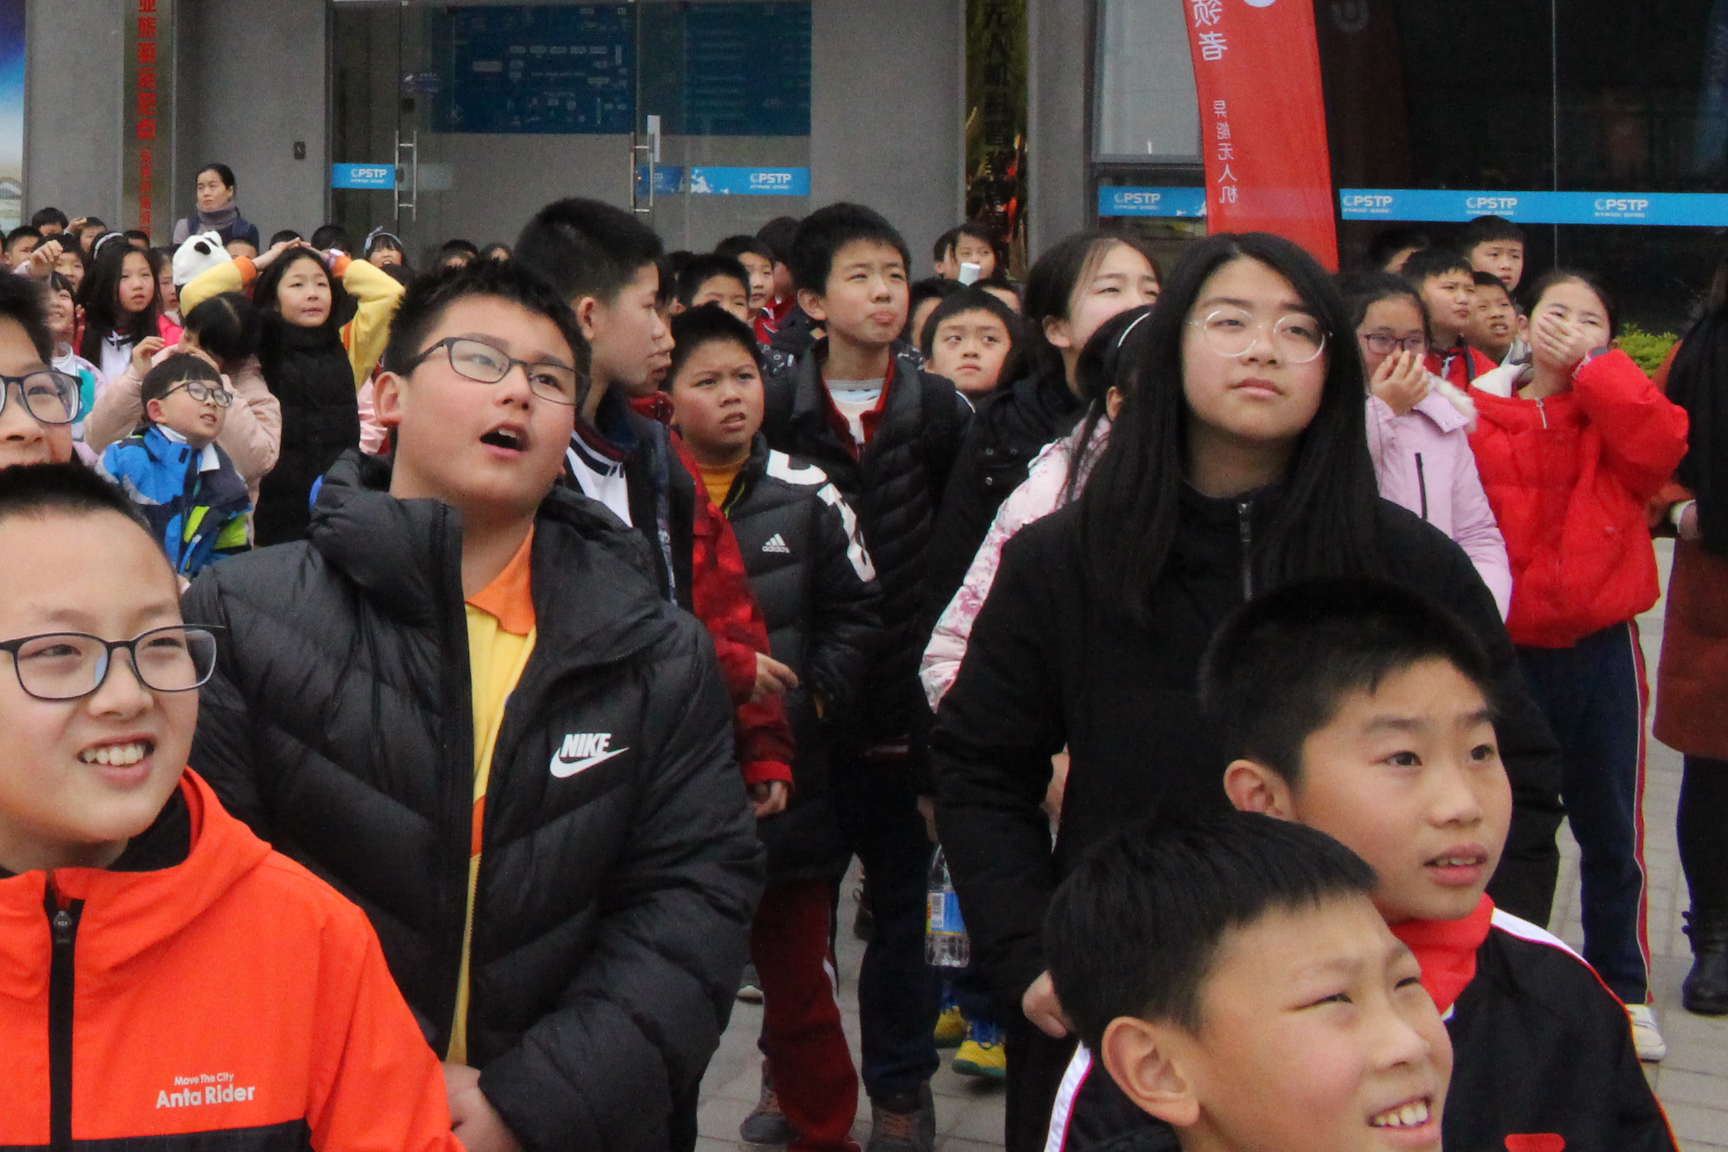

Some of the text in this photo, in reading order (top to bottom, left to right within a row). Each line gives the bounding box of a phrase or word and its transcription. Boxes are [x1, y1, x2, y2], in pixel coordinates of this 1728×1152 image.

[559, 732, 613, 759] NIKE
[174, 1071, 235, 1086] Move The City
[155, 1084, 256, 1109] Anta Rider
